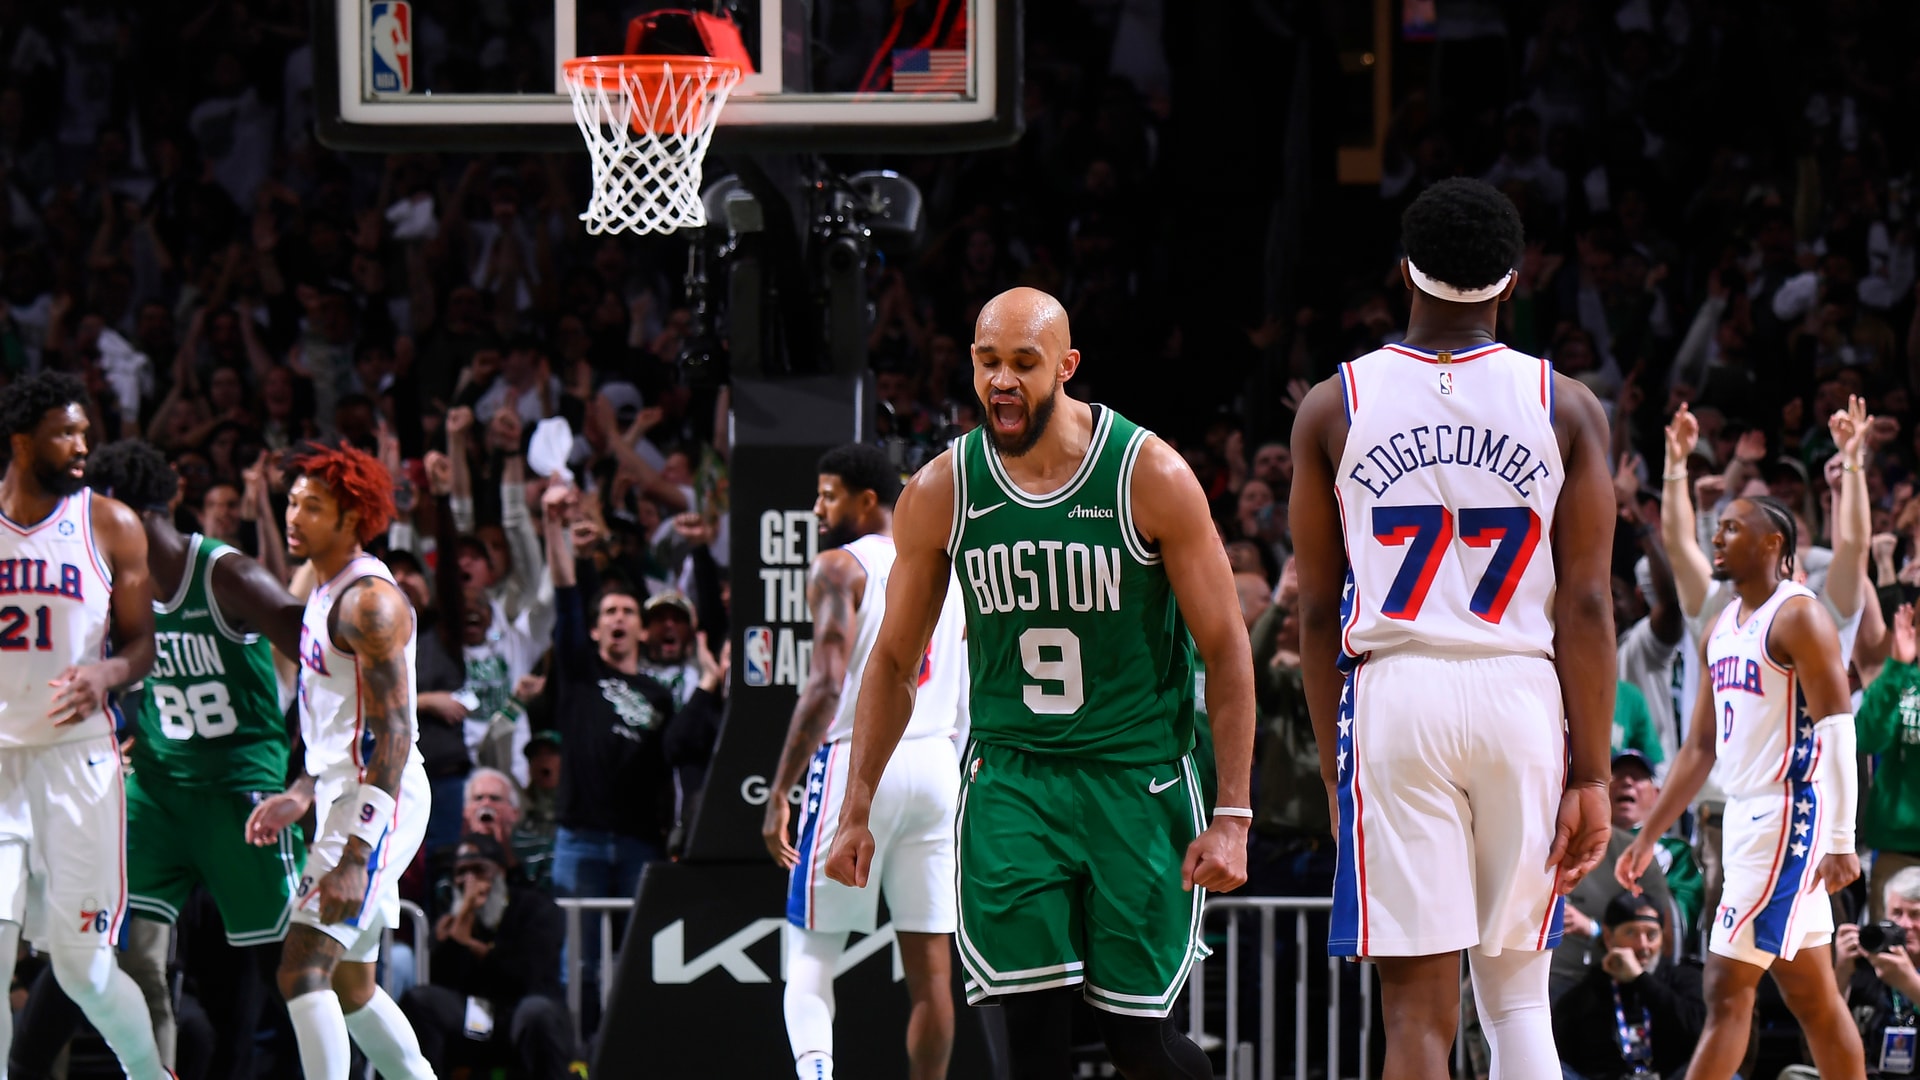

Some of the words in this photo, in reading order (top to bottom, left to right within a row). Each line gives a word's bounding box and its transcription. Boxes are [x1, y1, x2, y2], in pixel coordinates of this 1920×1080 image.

[1349, 424, 1550, 499] EDGECOMBE
[1067, 504, 1114, 518] Amica
[760, 509, 819, 565] GET
[0, 558, 84, 603] HILA
[964, 540, 1121, 615] BOSTON
[1371, 504, 1542, 625] 77
[0, 604, 53, 652] 21
[151, 631, 226, 678] STON
[774, 628, 814, 696] Ap
[1018, 628, 1085, 715] 9
[1710, 656, 1765, 697] PHILA
[152, 681, 239, 741] 88
[1723, 700, 1734, 743] 0
[360, 803, 375, 823] 9
[80, 909, 108, 934] 76
